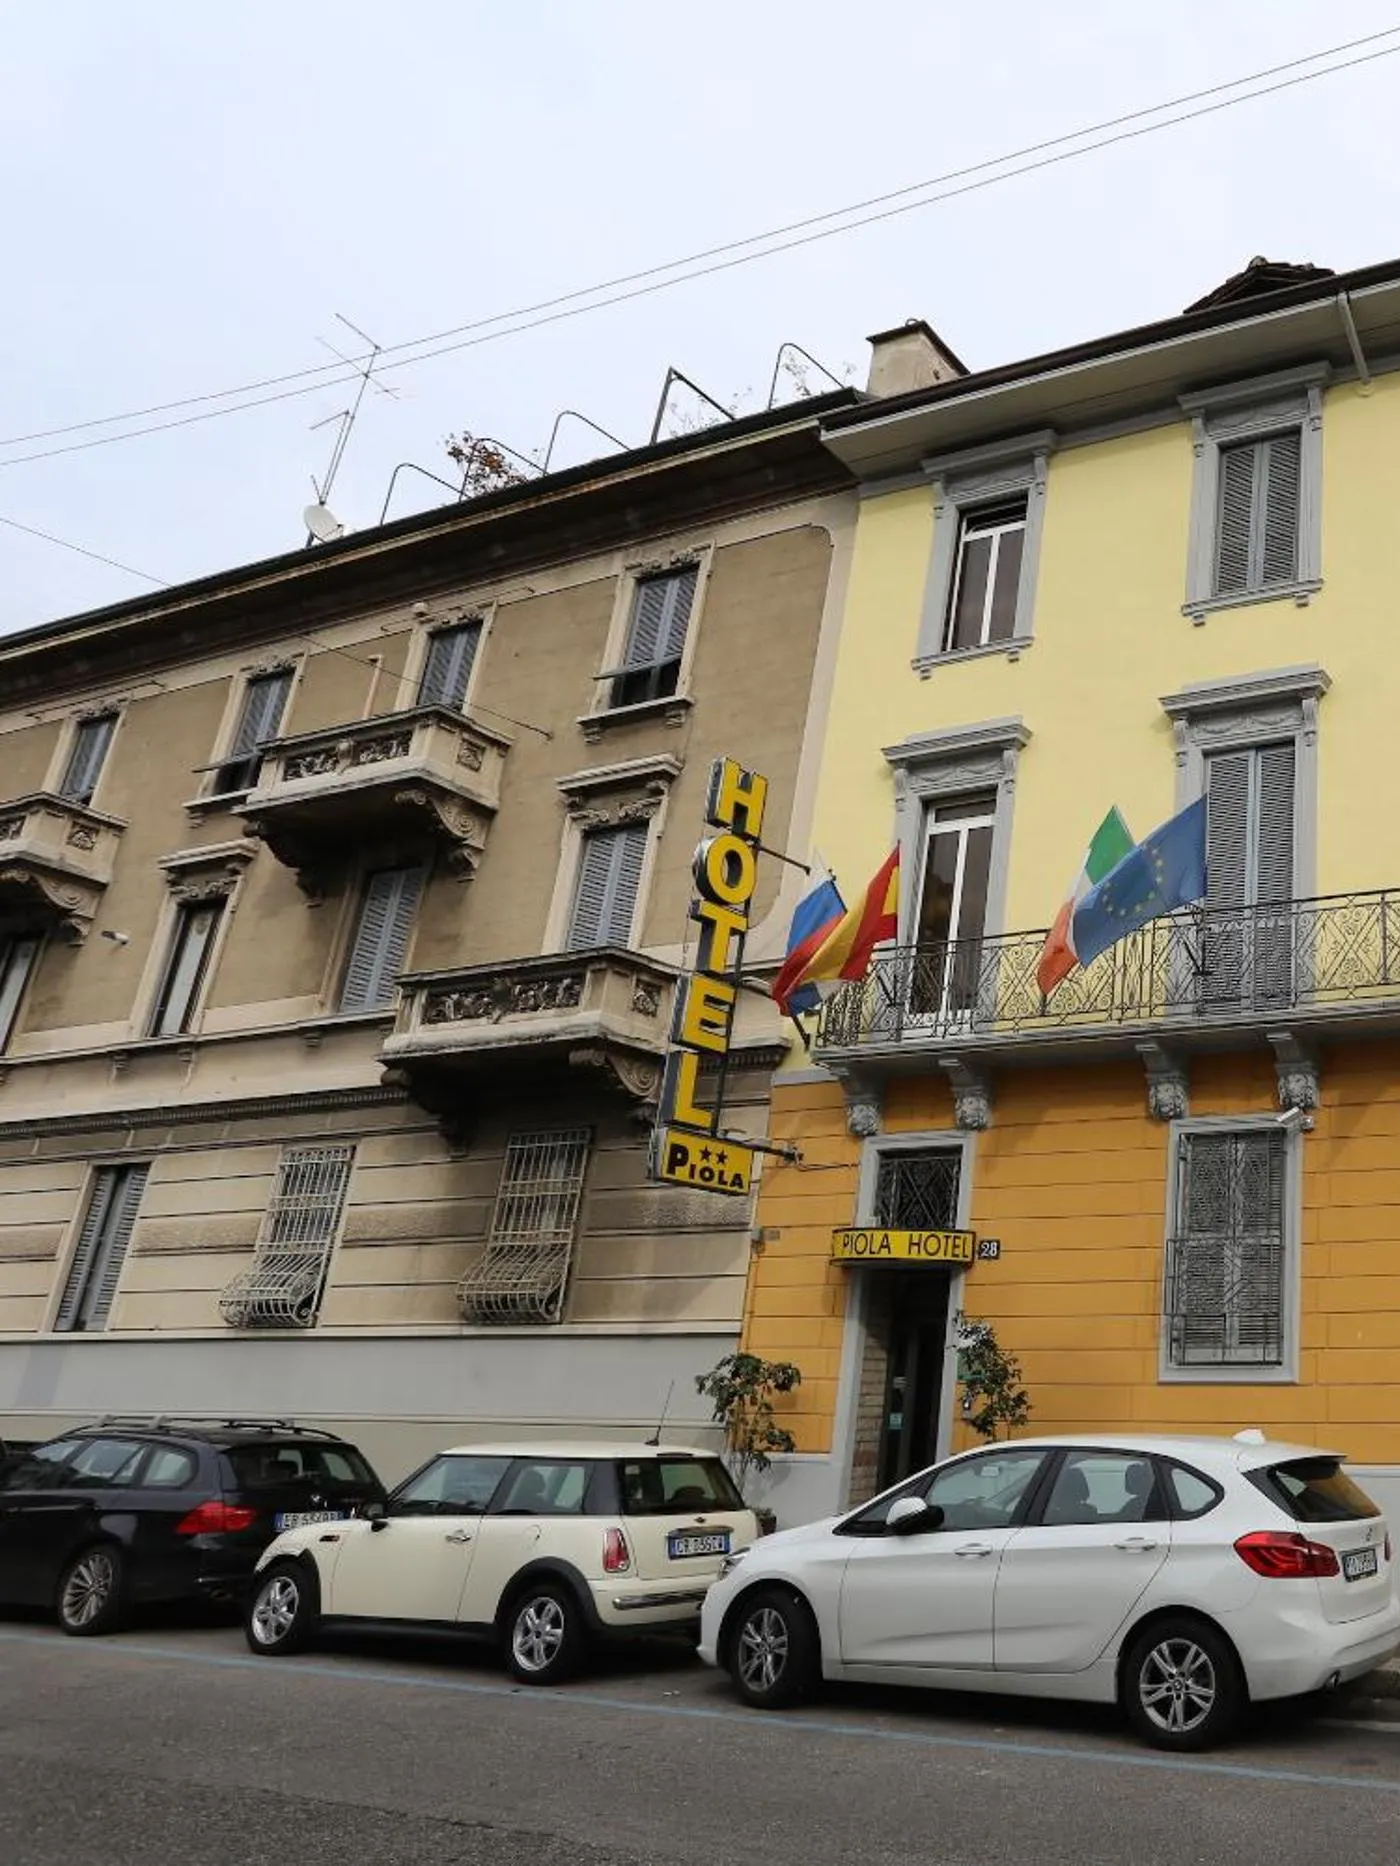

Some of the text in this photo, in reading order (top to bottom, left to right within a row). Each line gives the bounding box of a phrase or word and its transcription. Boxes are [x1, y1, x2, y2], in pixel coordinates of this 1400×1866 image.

[668, 757, 768, 1129] HOTEL
[666, 1143, 744, 1189] PIOLA
[843, 1233, 969, 1258] PIOLA HOTEL
[981, 1240, 998, 1257] 28
